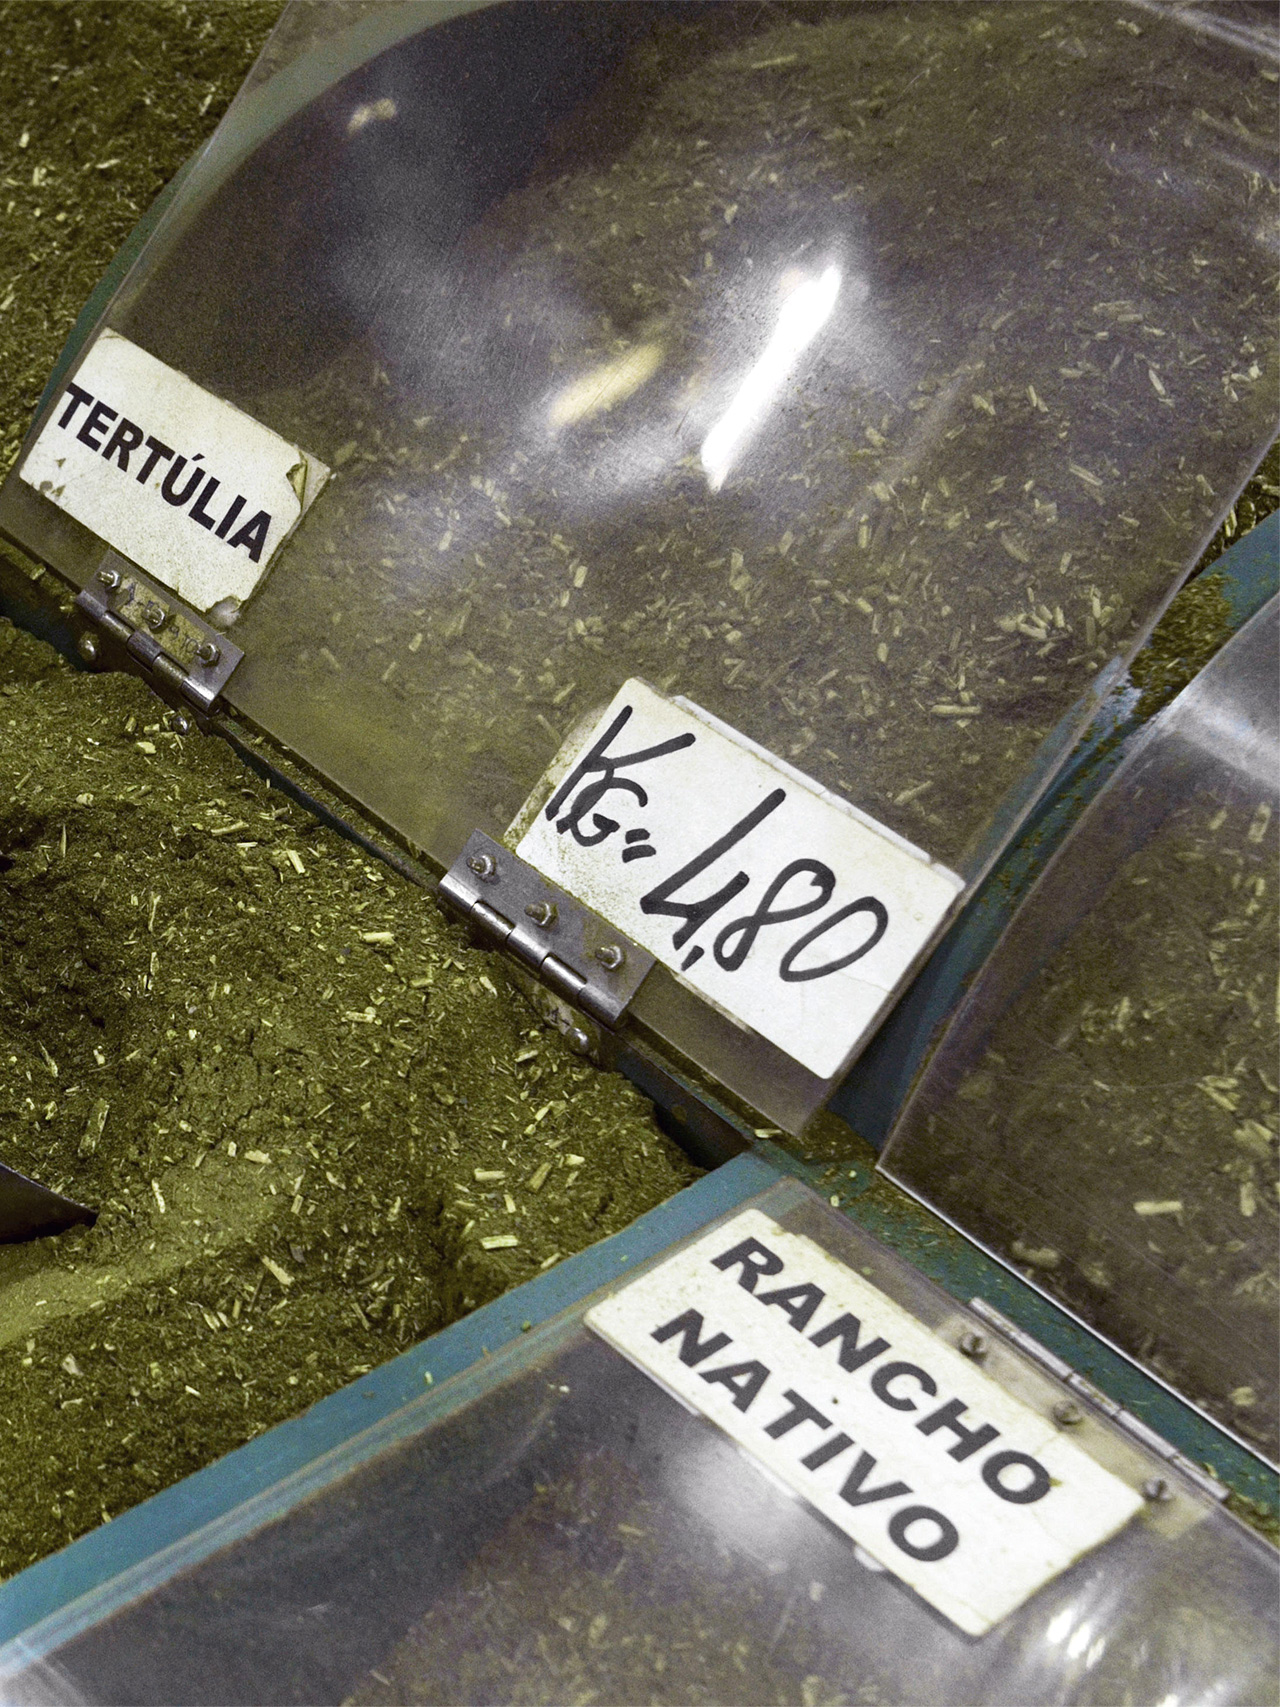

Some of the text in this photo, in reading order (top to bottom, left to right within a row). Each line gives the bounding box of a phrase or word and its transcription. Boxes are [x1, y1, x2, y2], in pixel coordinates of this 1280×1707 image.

[57, 381, 273, 564] TERTÚLIA
[640, 788, 889, 983] 4,80
[650, 1308, 960, 1563] NATIVO
[710, 1236, 1054, 1506] RANCHO
